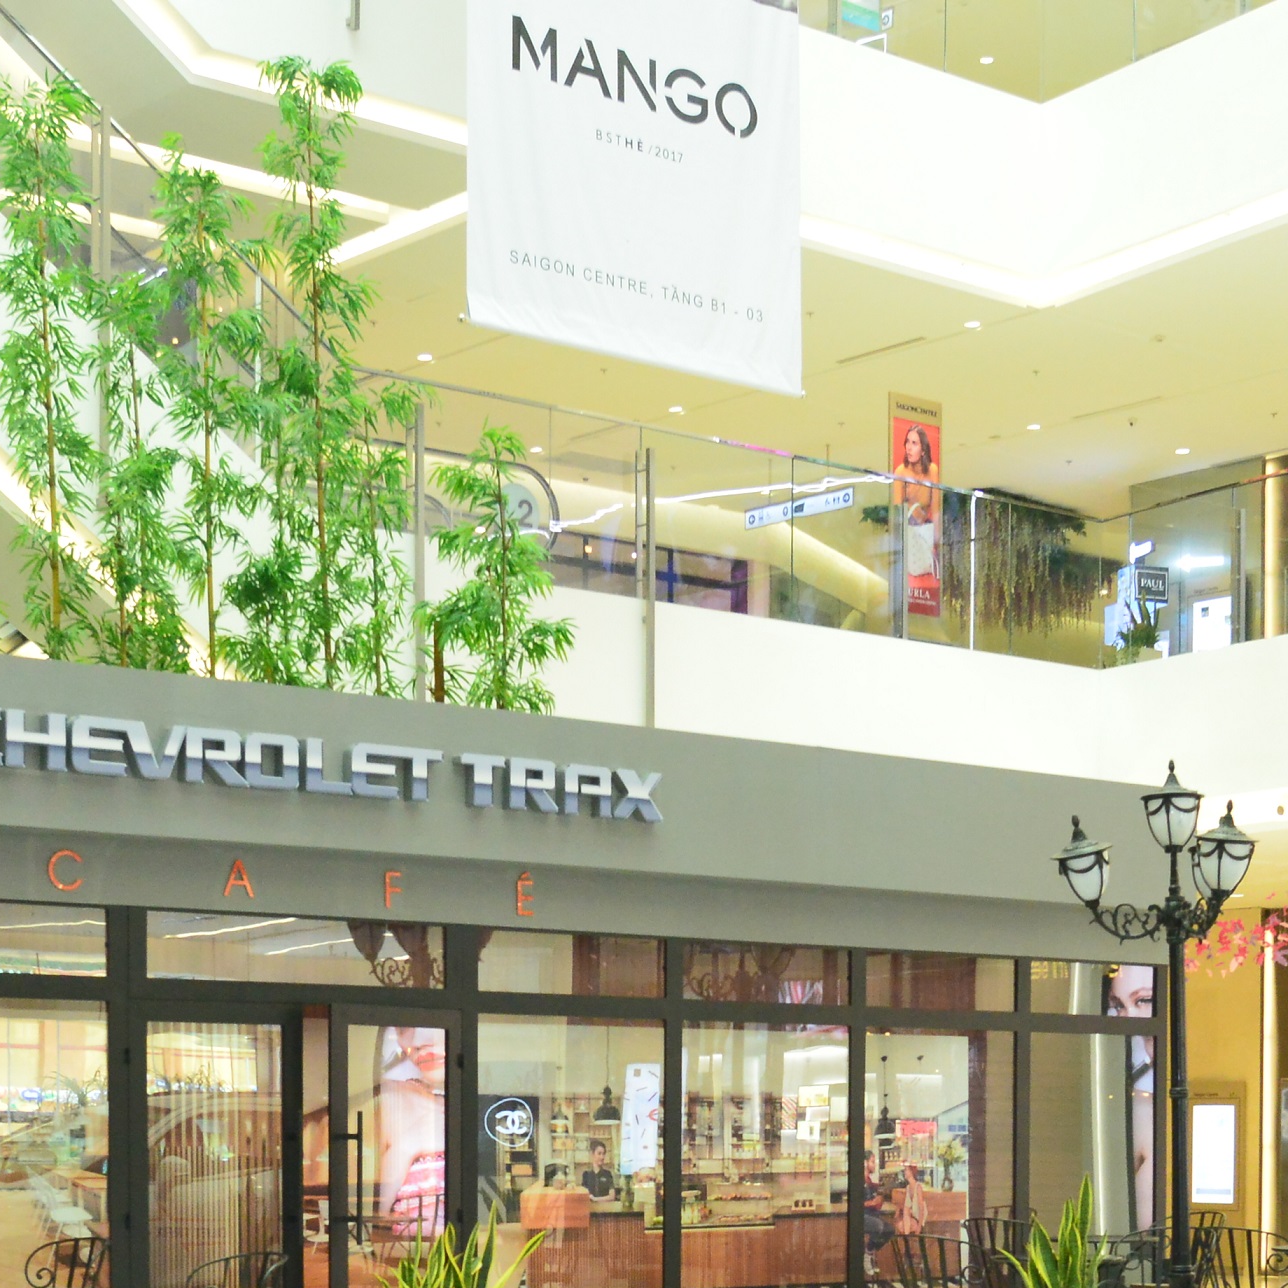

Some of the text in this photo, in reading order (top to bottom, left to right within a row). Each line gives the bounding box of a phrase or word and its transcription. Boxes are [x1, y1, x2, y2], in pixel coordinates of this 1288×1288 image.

[512, 14, 758, 139] MANGO
[509, 250, 575, 277] SAIGON
[583, 268, 653, 298] CENTRE,
[907, 588, 930, 599] URLA
[1140, 577, 1165, 589] PAUL
[459, 751, 664, 823] TRAX
